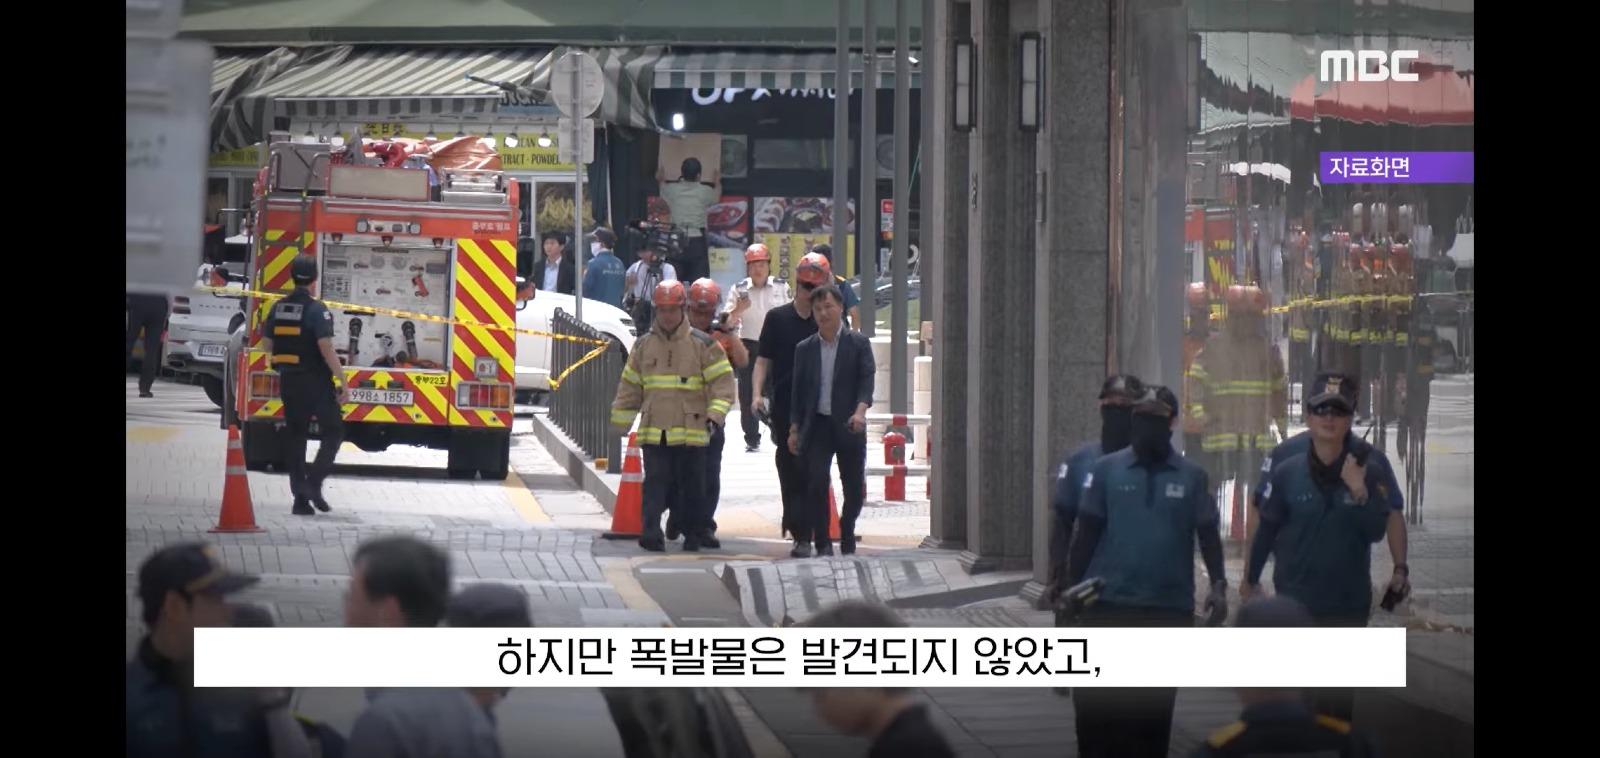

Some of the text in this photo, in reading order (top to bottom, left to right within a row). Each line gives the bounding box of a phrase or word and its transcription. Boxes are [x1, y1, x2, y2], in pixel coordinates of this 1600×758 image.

[503, 153, 525, 164] TRACT
[351, 390, 410, 402] 998소 1857
